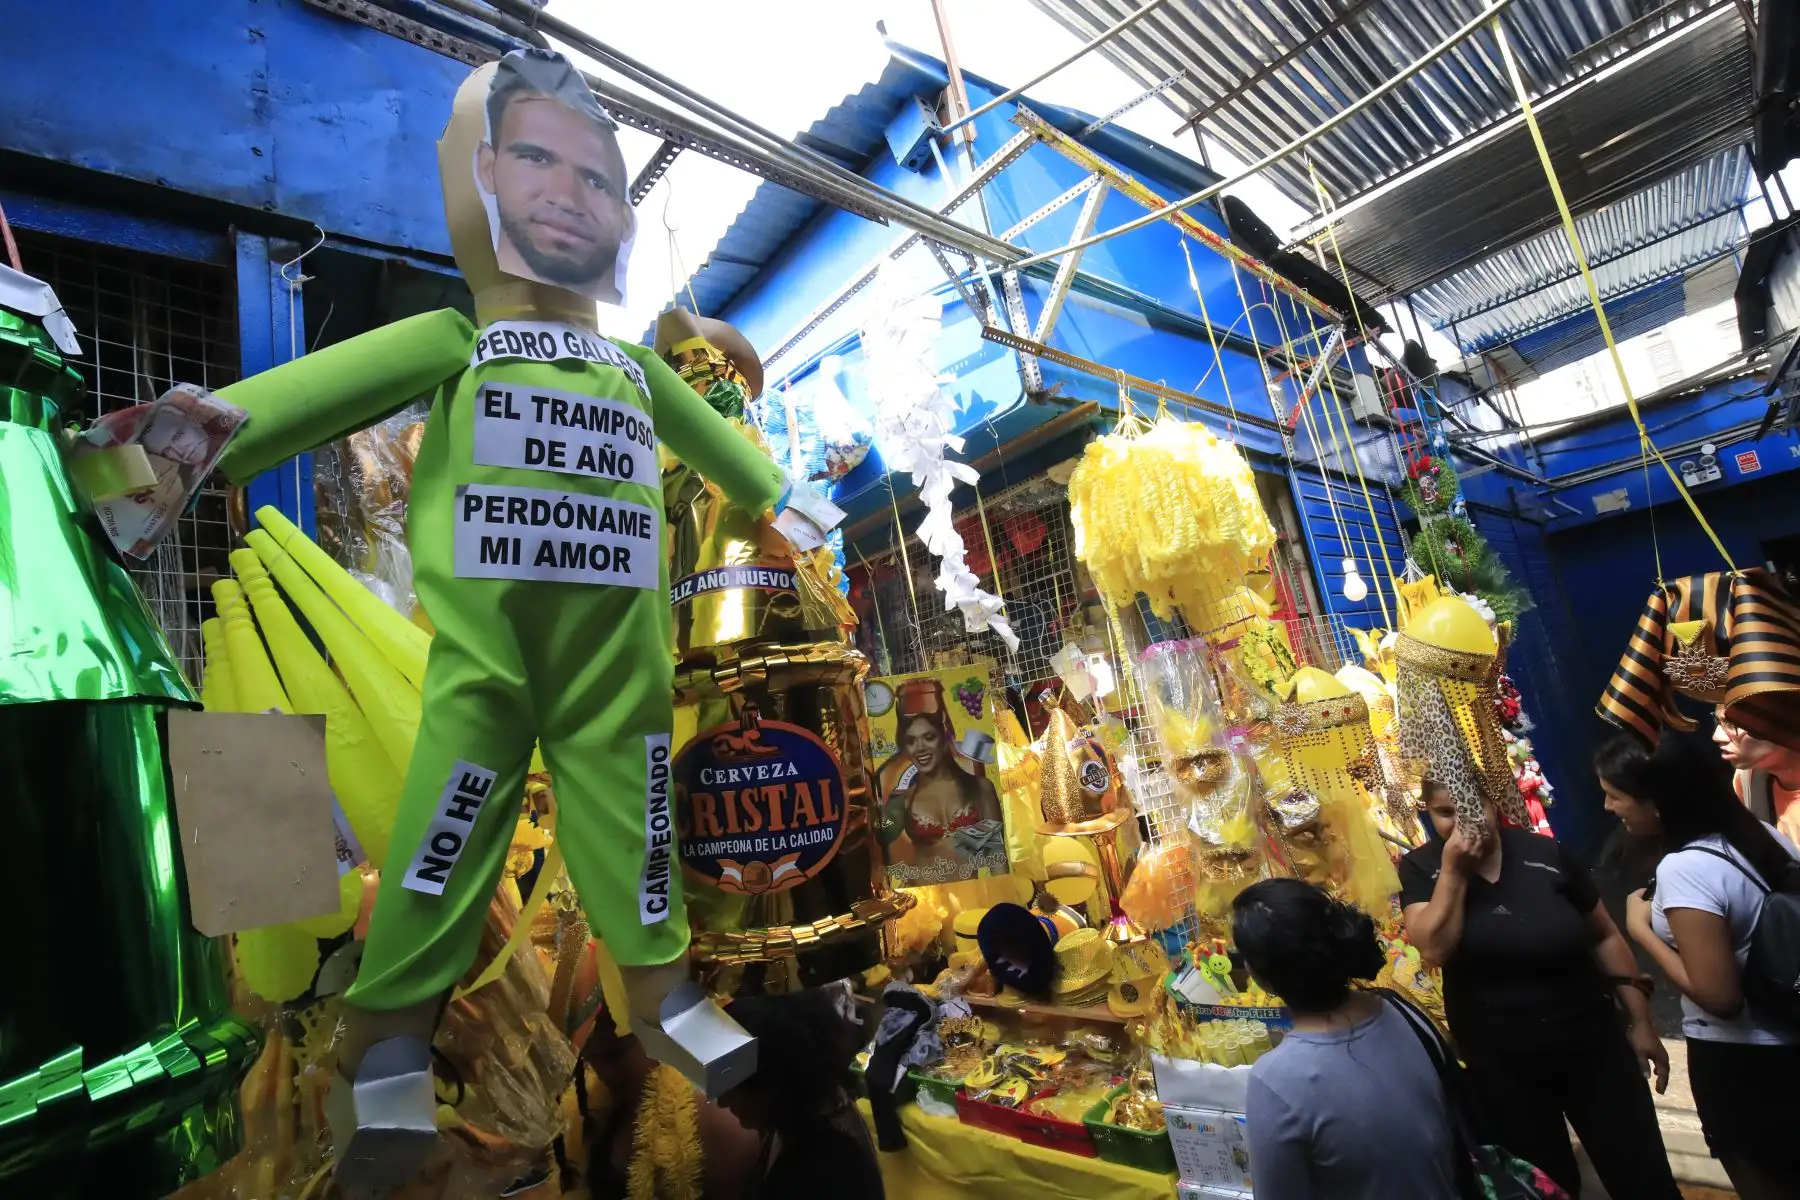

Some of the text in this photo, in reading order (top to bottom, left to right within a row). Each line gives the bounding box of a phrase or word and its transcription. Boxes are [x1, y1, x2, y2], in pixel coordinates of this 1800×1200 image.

[475, 329, 557, 361] PEDRO
[484, 389, 653, 451] EL TRAMPOSO
[524, 437, 634, 480] DE AÑO
[463, 494, 652, 540] PERDÓNAME
[480, 535, 631, 574] MI AMOR
[697, 570, 730, 592] AÑO
[735, 570, 790, 588] NUEVO
[700, 761, 799, 785] CERVEZA
[415, 771, 492, 885] NO HE
[646, 745, 672, 914] CAMPEONADO
[683, 827, 834, 857] LA CAMPEONA DE LA CALIDAD
[1250, 1008, 1281, 1019] FREE
